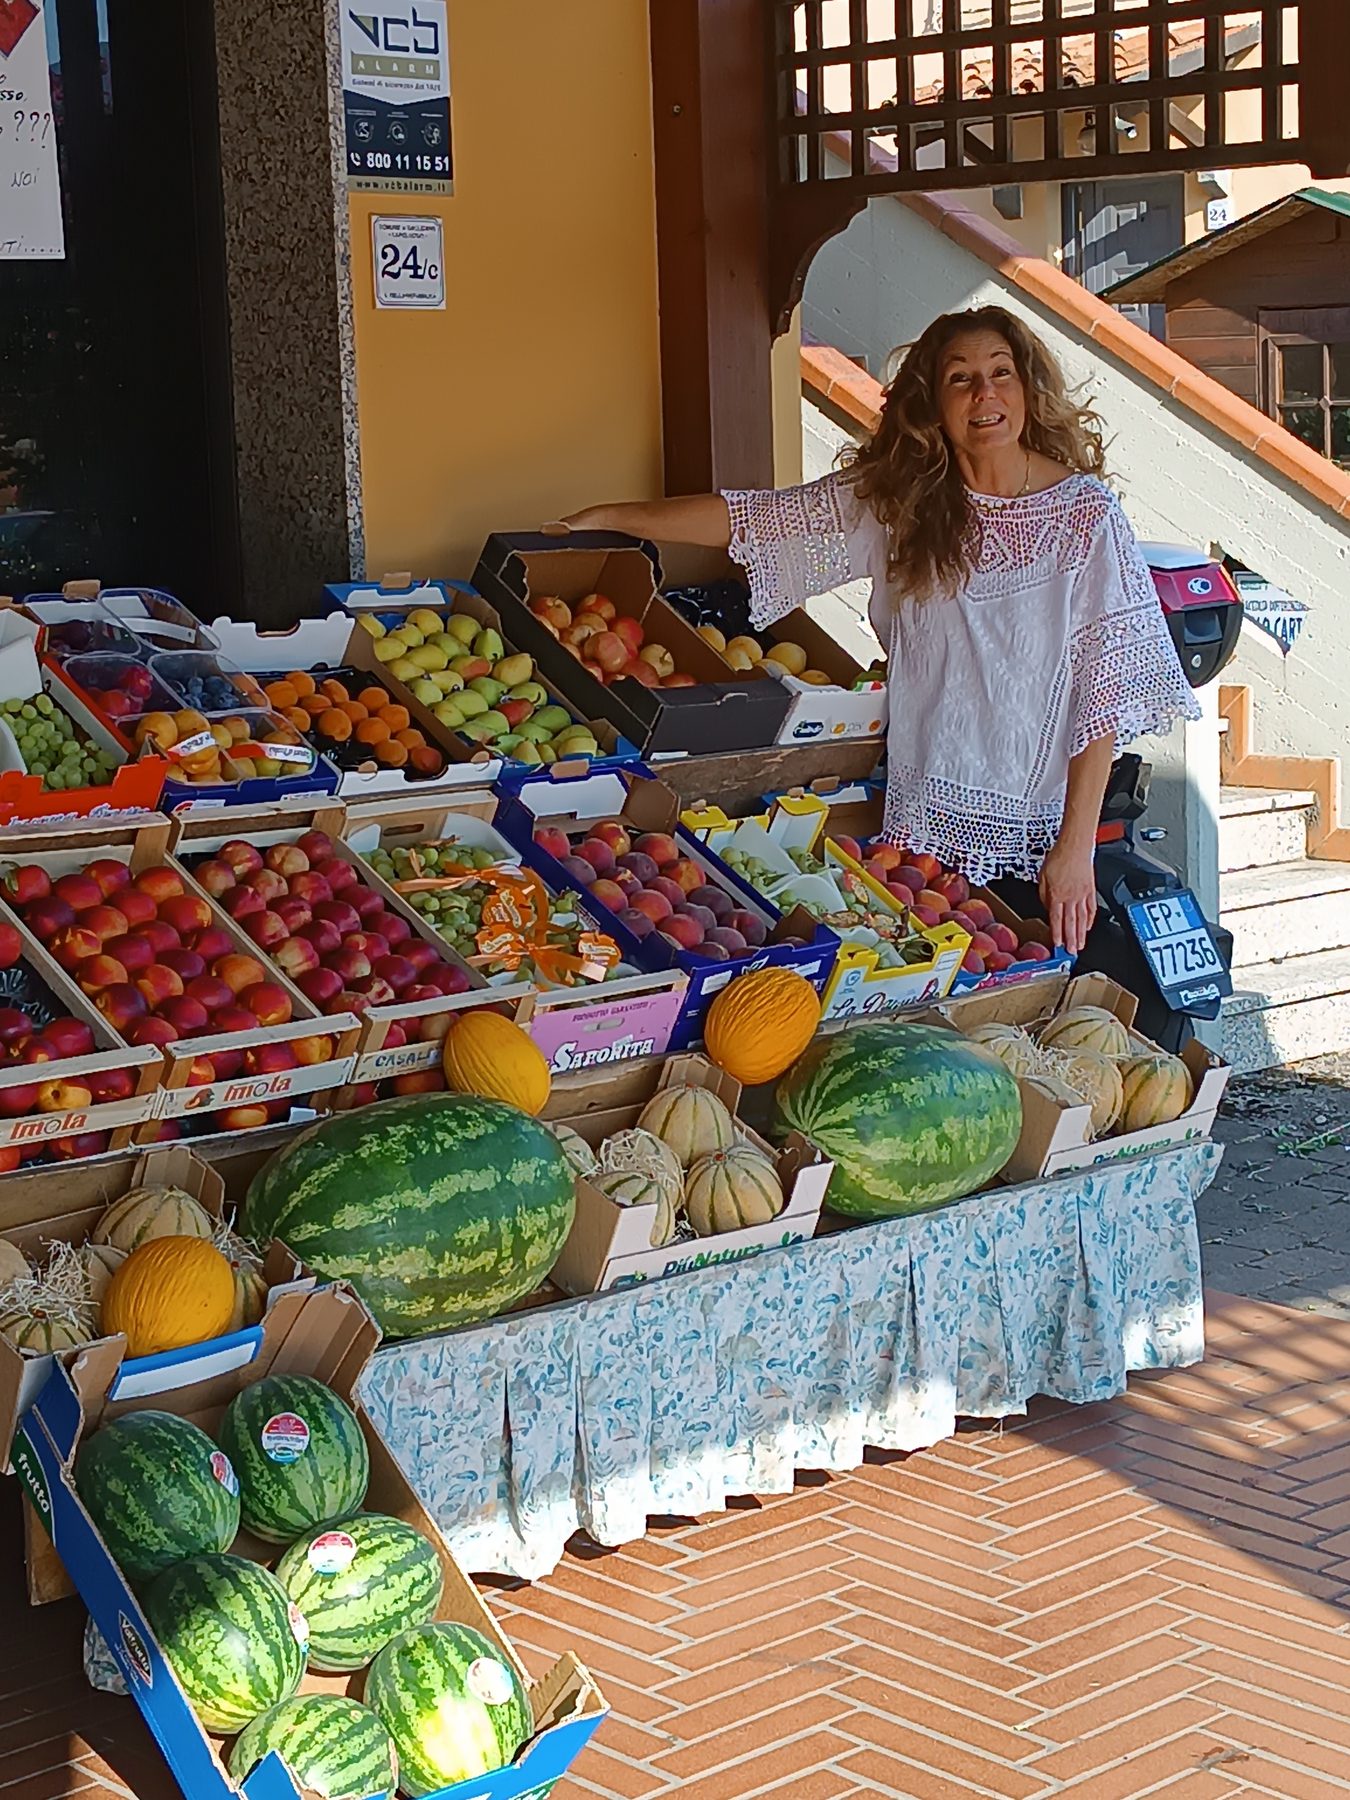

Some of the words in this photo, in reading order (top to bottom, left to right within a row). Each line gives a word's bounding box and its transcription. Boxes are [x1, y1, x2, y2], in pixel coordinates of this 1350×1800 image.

[357, 60, 434, 75] ALARM
[366, 152, 391, 169] 800
[395, 153, 410, 170] 11
[434, 155, 449, 172] 51
[1210, 208, 1227, 221] 24
[1146, 902, 1172, 935] FP
[1149, 937, 1217, 978] 77236
[223, 1075, 292, 1102] Imola
[10, 1112, 88, 1140] Imola
